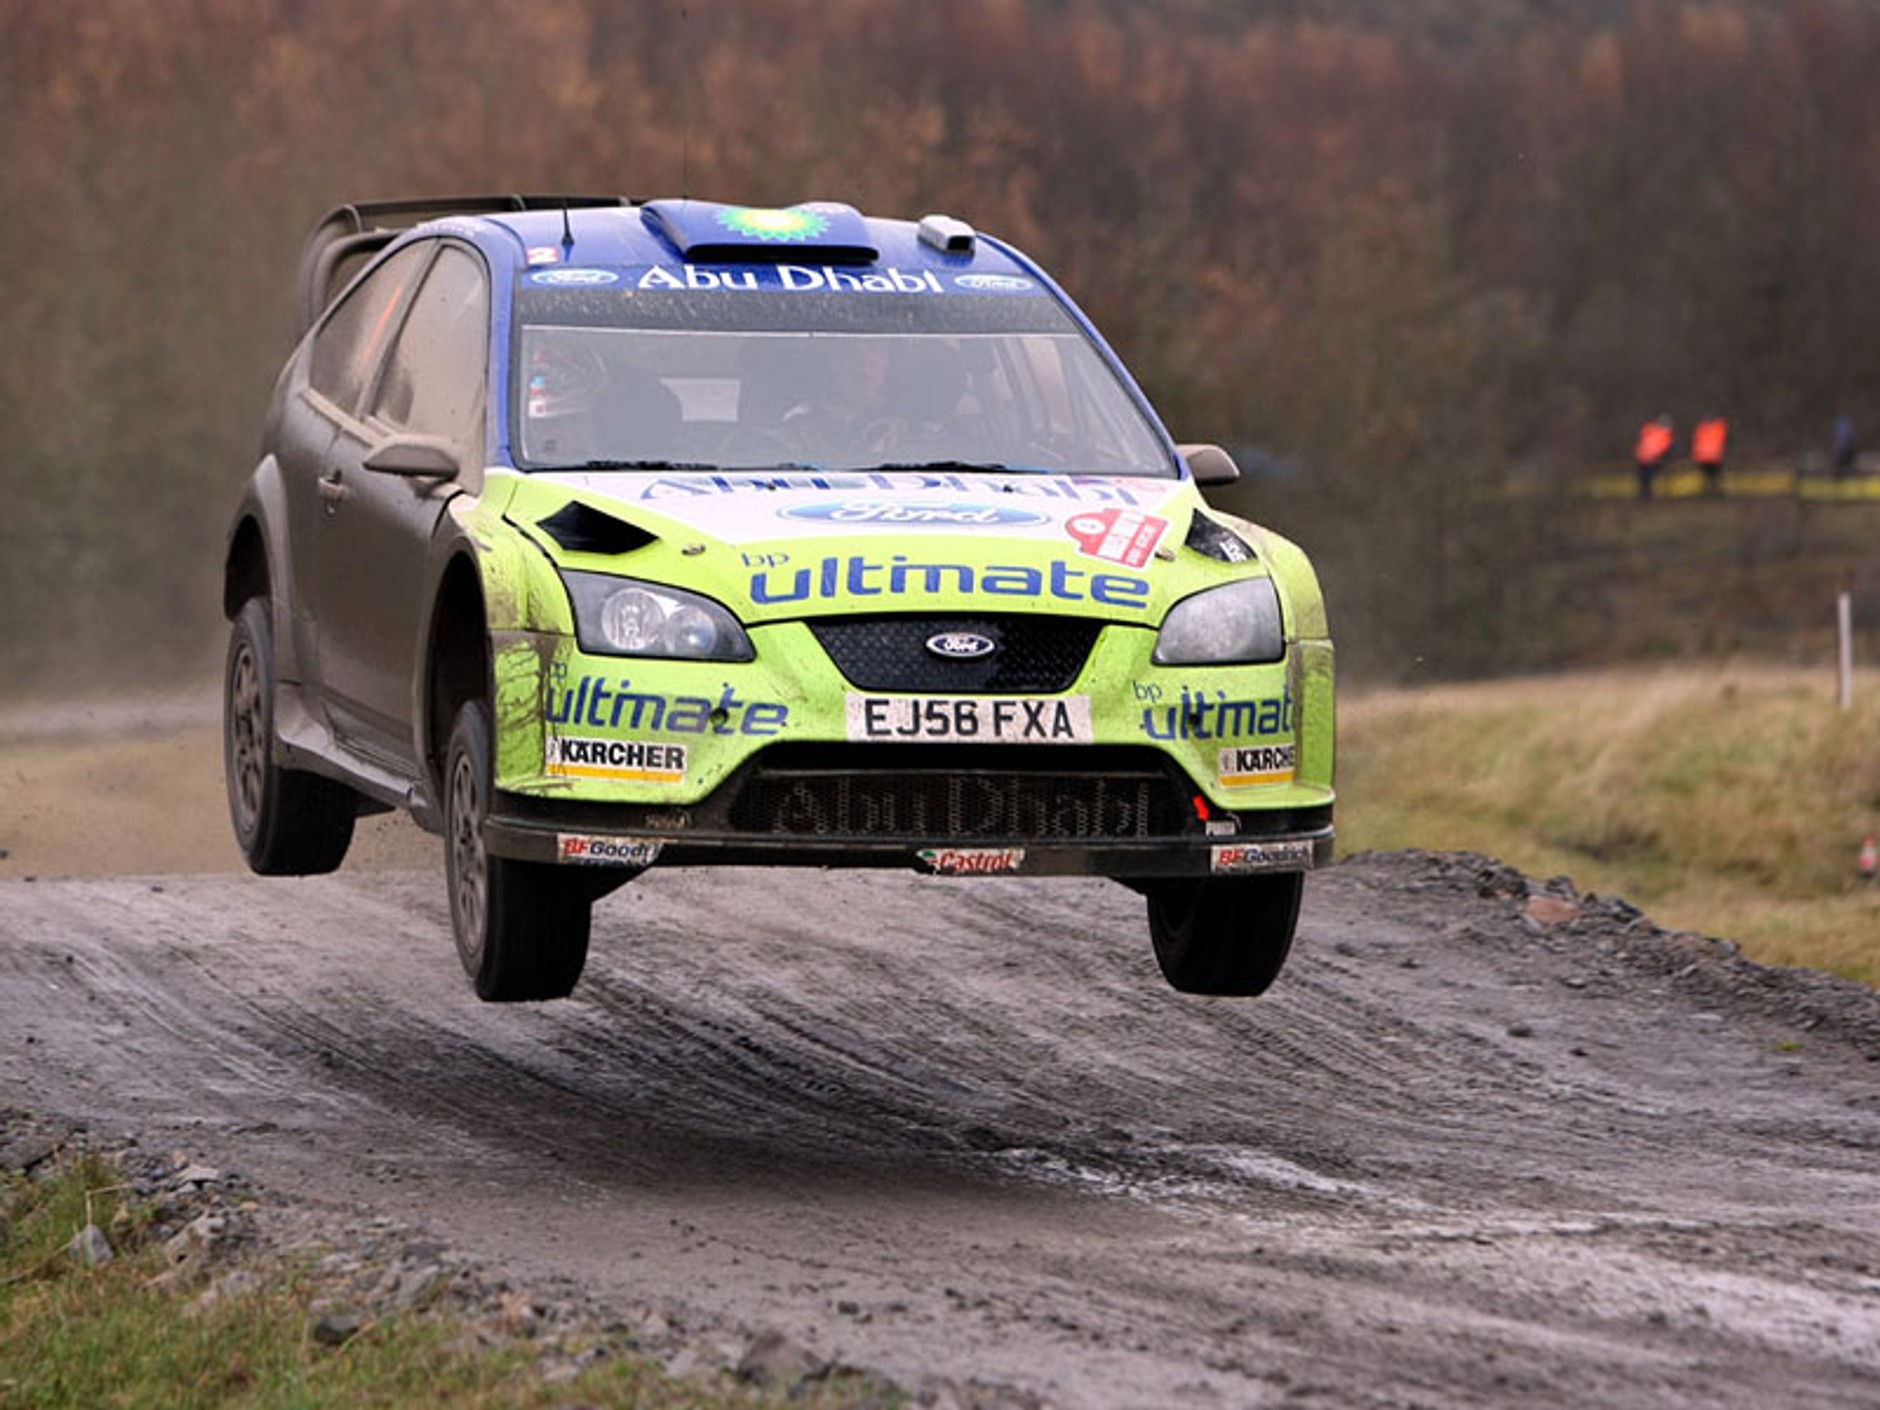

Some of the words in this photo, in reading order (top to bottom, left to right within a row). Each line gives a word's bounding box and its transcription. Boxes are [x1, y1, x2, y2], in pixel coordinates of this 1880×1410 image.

[638, 264, 758, 289] Abu
[777, 266, 945, 293] Dhabi
[828, 502, 1000, 524] Ford
[742, 552, 790, 568] bp
[750, 556, 1150, 609] ultimate
[546, 675, 789, 736] ultimate
[1133, 679, 1162, 702] bp
[864, 699, 977, 738] EJ56
[993, 699, 1075, 738] FXA
[1142, 683, 1295, 741] ultimat
[560, 738, 685, 770] KÄRCHER
[937, 849, 1015, 873] Castrol
